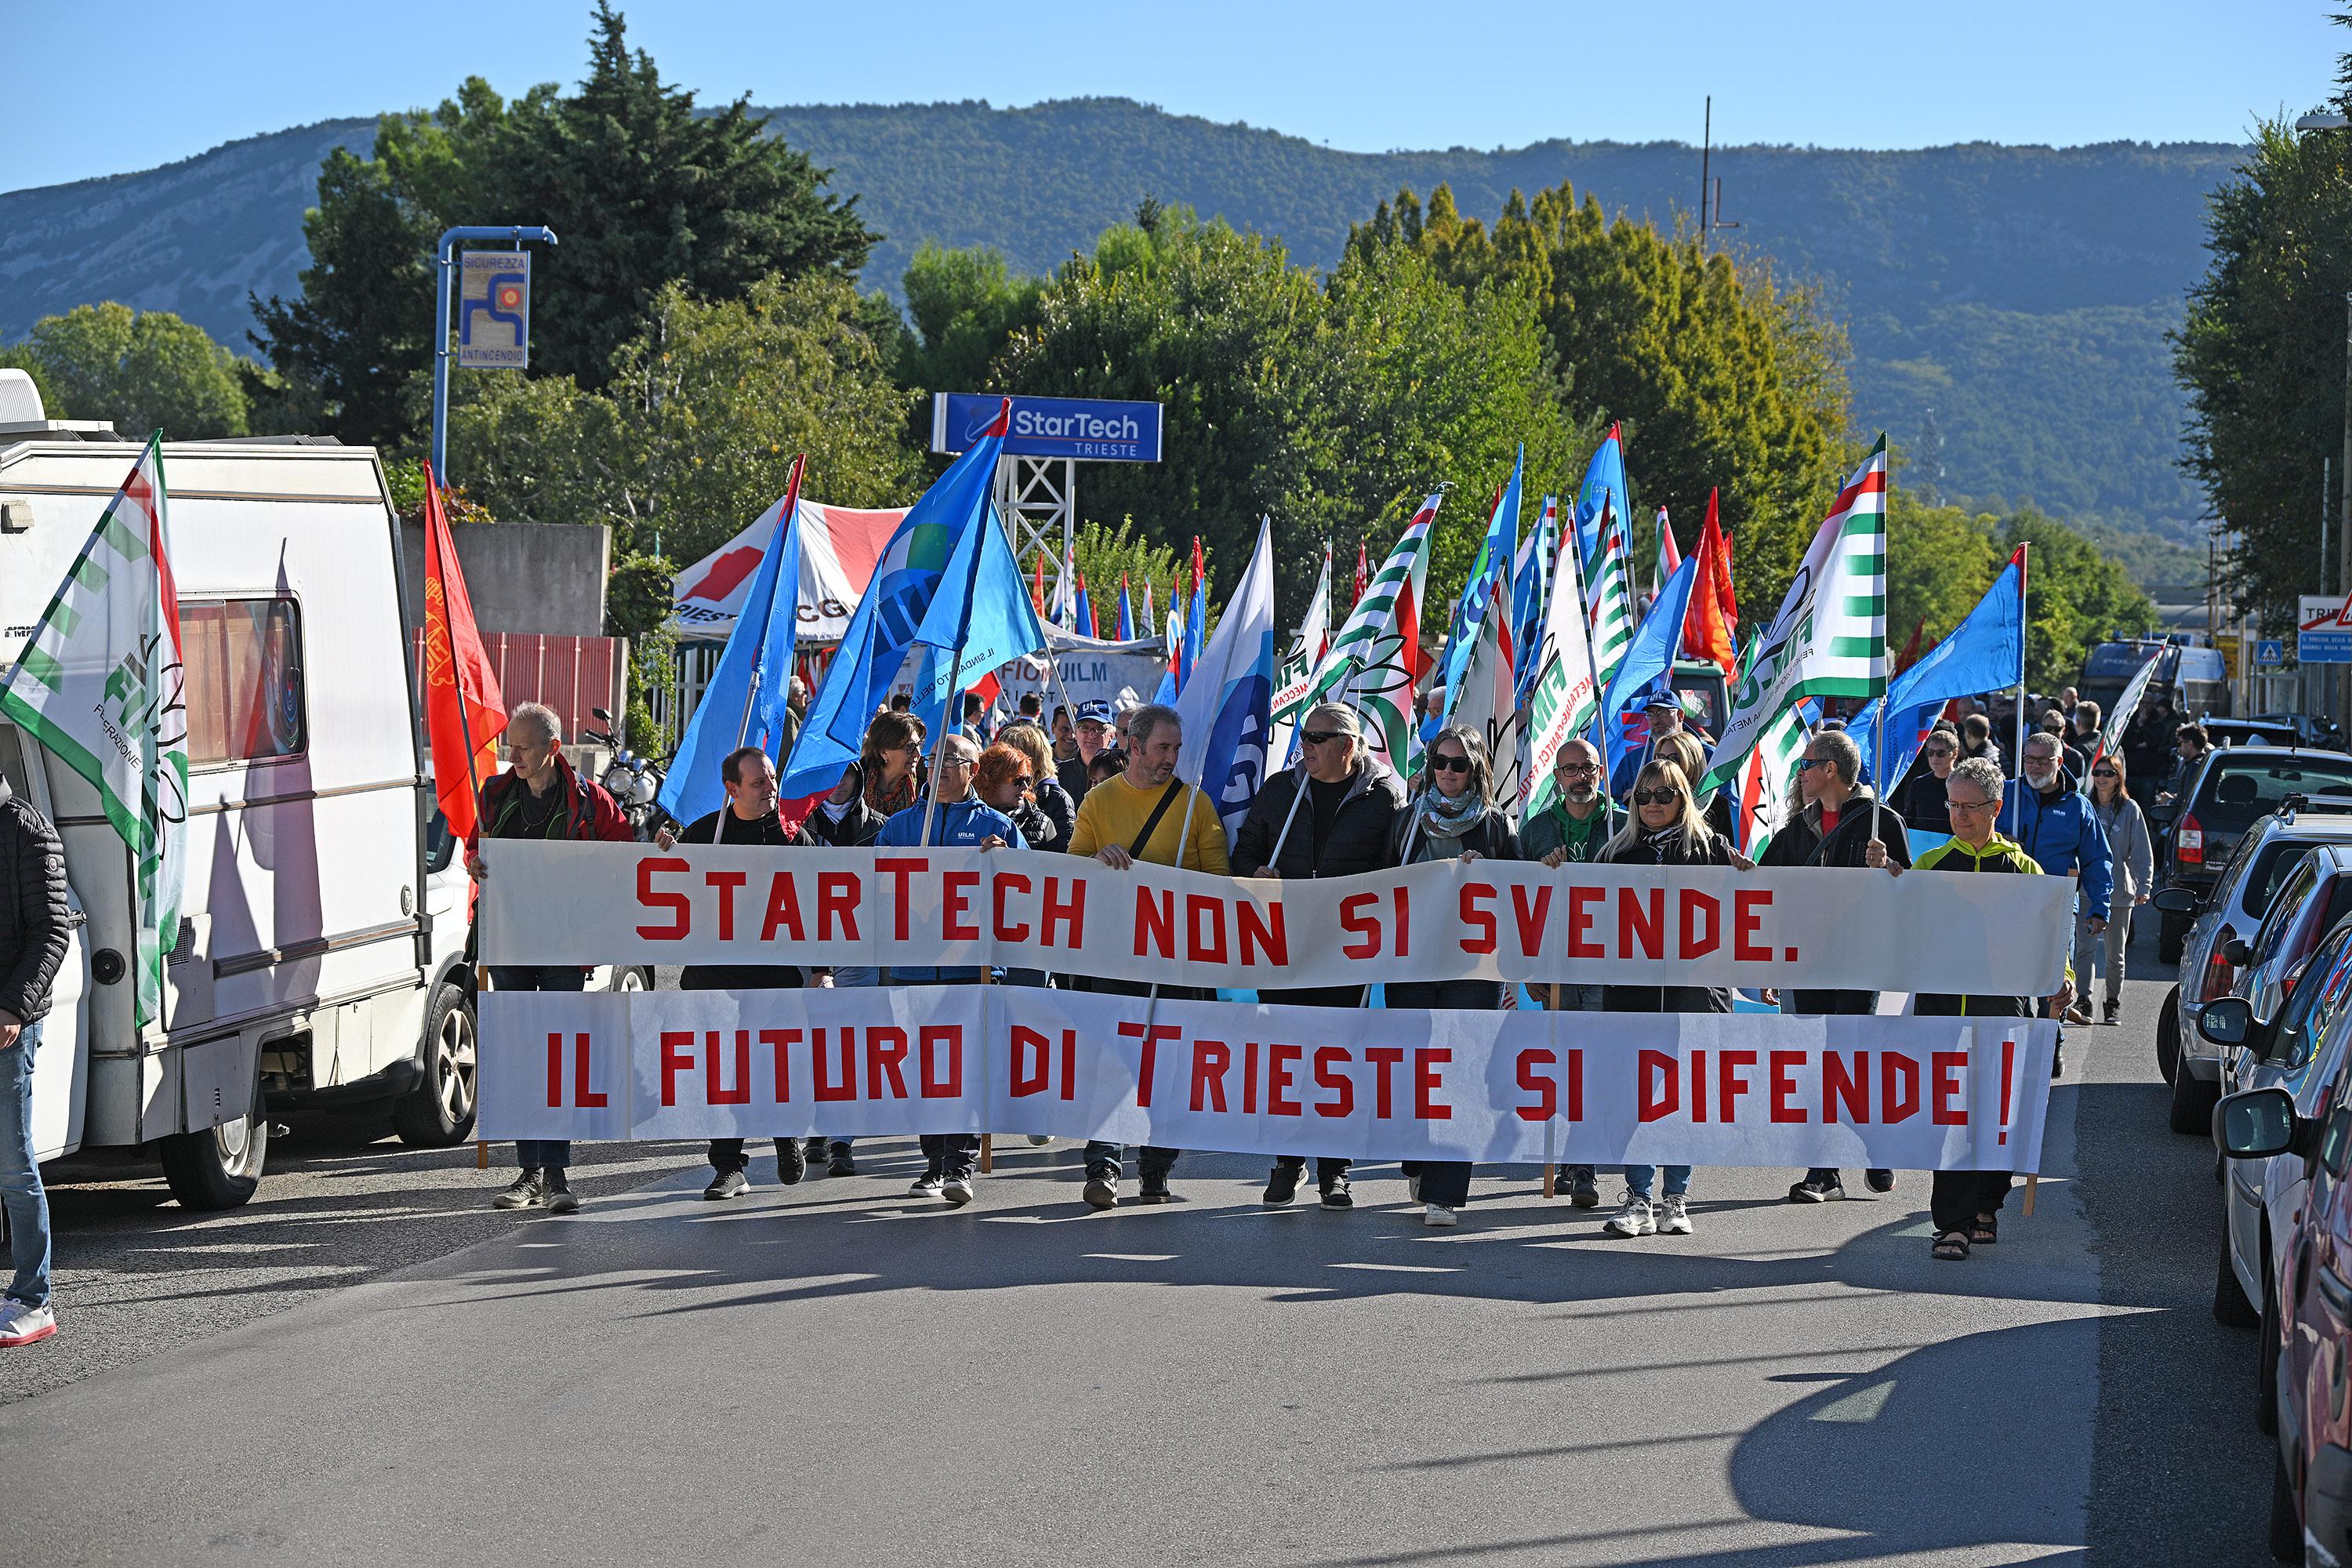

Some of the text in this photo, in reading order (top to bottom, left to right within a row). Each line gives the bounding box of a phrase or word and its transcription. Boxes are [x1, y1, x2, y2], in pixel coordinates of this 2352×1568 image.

[463, 257, 525, 269] SICUREZZA
[461, 349, 523, 361] ANTINCENDIO
[1015, 410, 1138, 439] StarTech
[1075, 442, 1137, 456] TRIESTE
[1134, 886, 1288, 967] NON
[1340, 887, 1409, 960] SI
[1459, 883, 1798, 963] SVENDE.
[547, 1033, 608, 1108] IL
[660, 1025, 963, 1107] FUTURO
[1010, 1025, 1076, 1101] DI
[1516, 1048, 1583, 1121] SI
